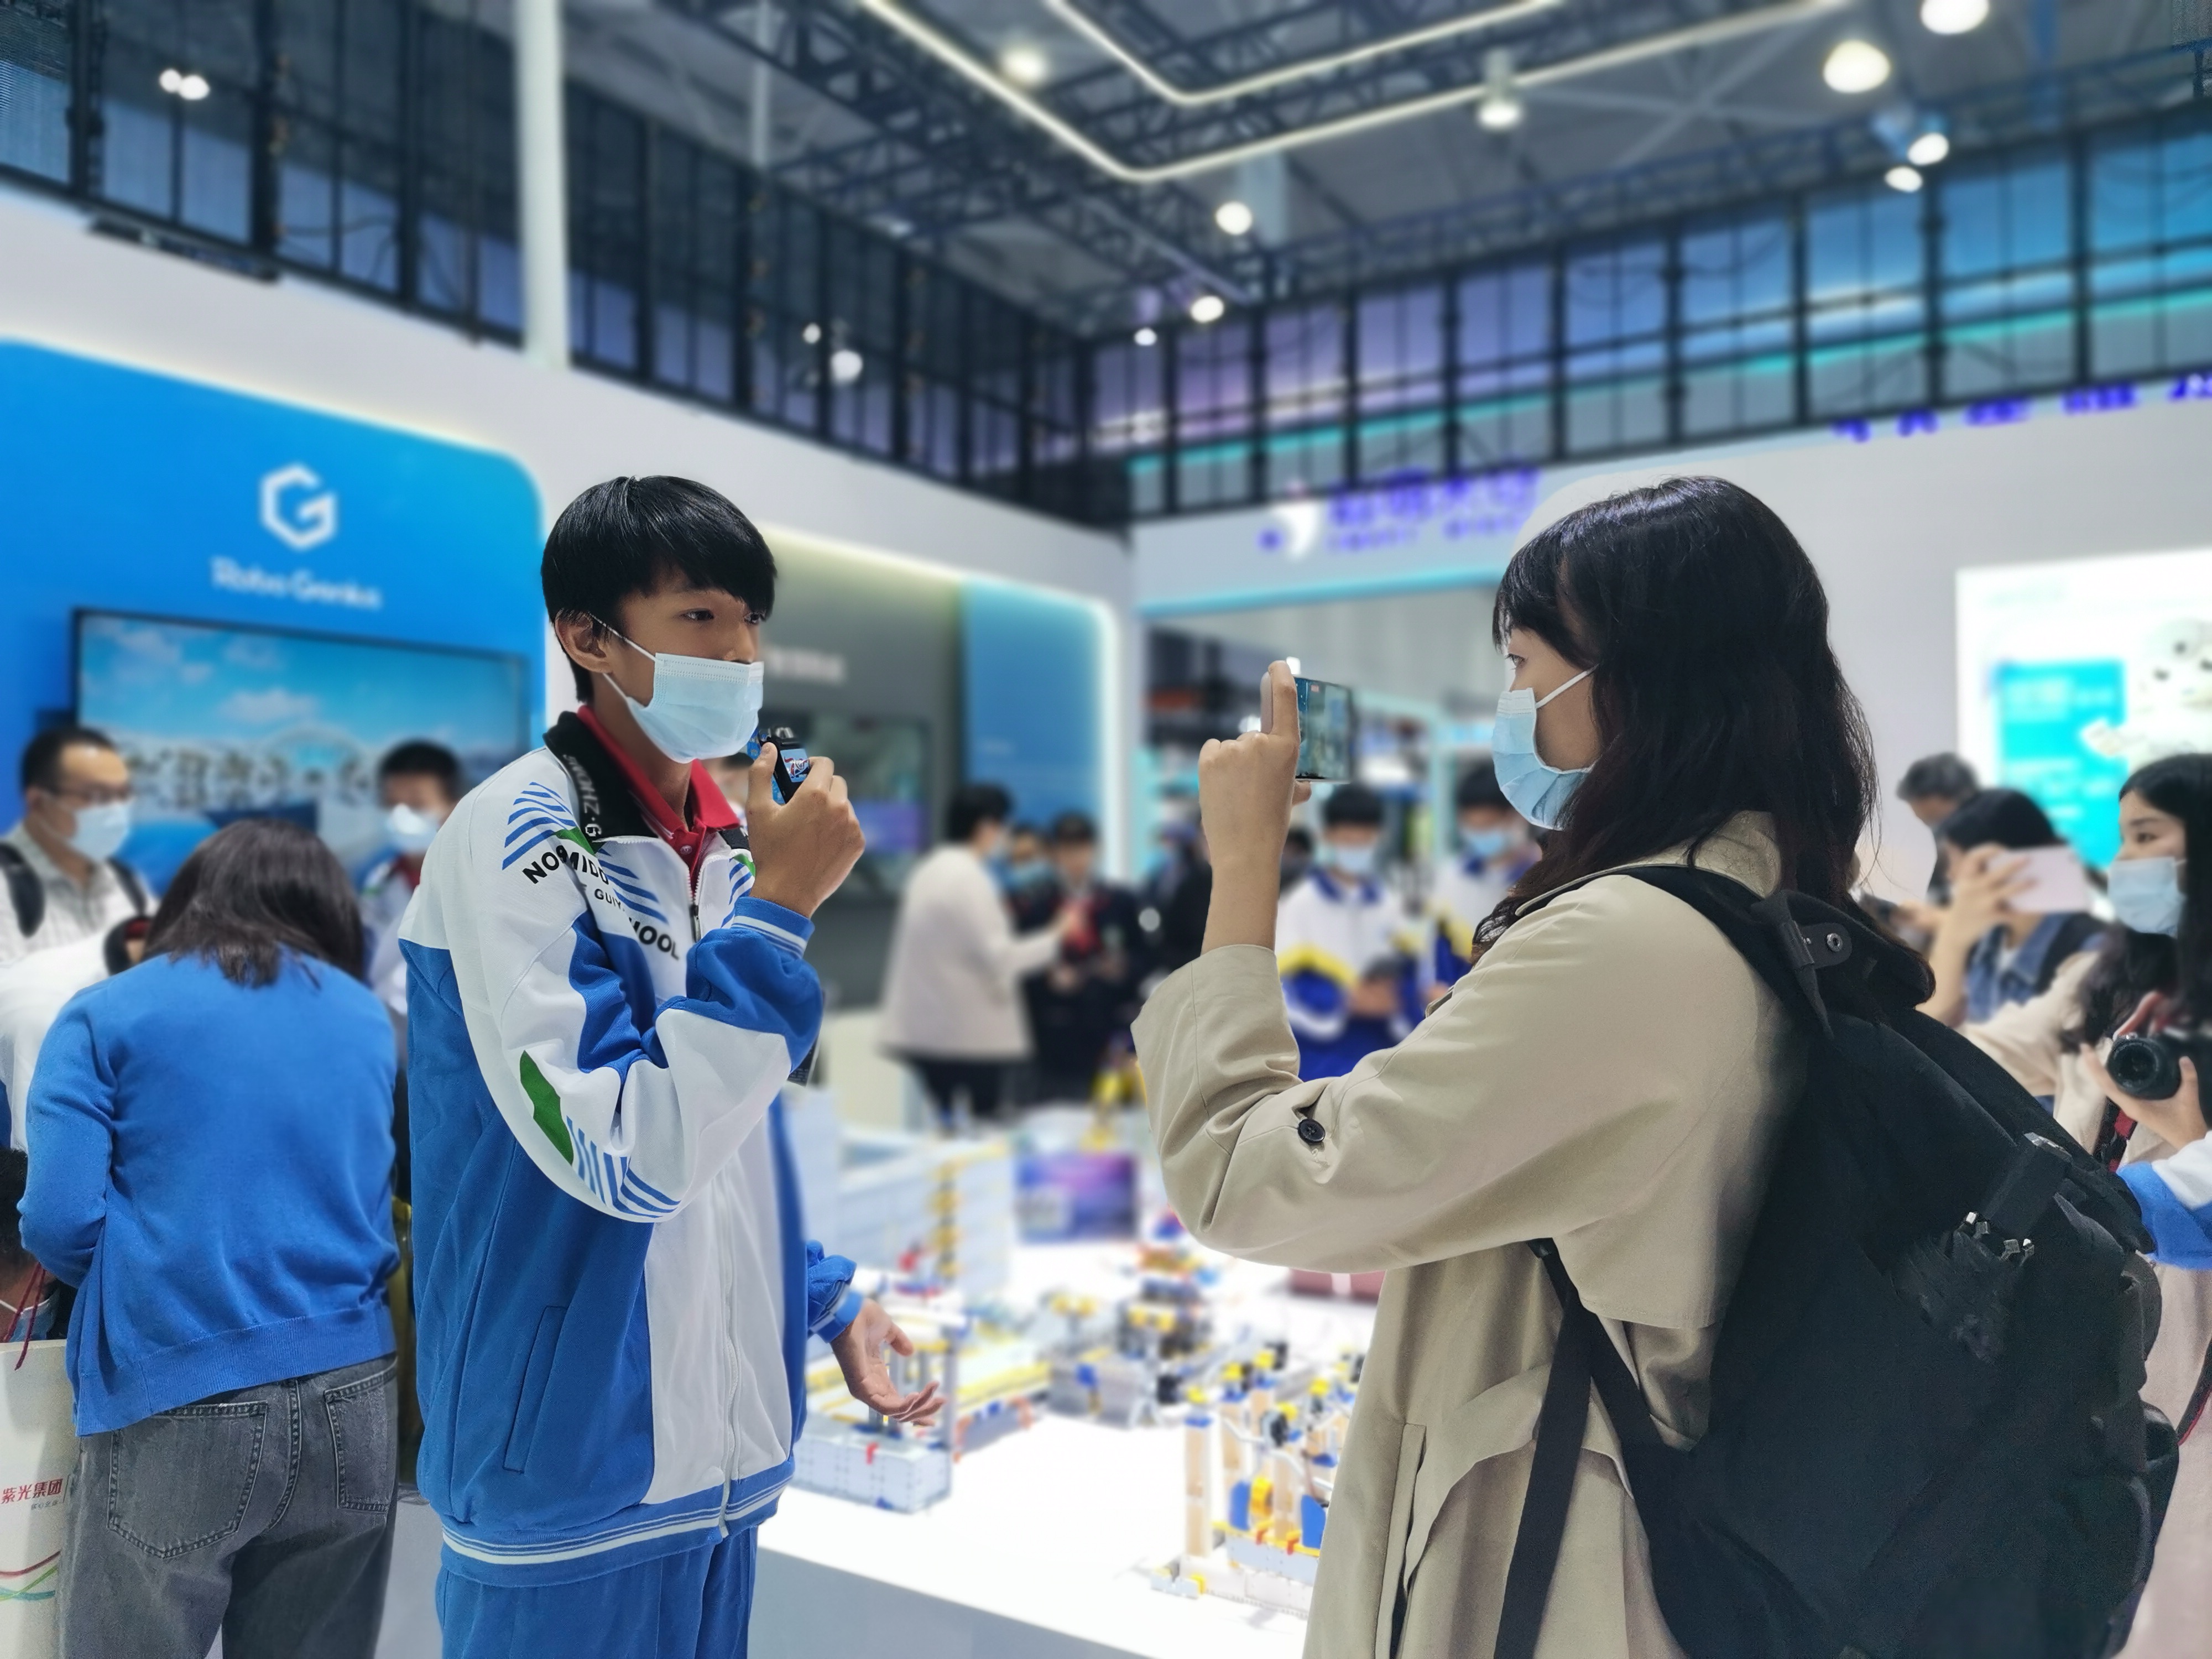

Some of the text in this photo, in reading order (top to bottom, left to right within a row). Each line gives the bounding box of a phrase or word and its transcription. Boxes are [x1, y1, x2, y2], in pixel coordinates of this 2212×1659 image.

[594, 888, 624, 911] GUIY
[1, 1478, 64, 1504] 紫光集团
